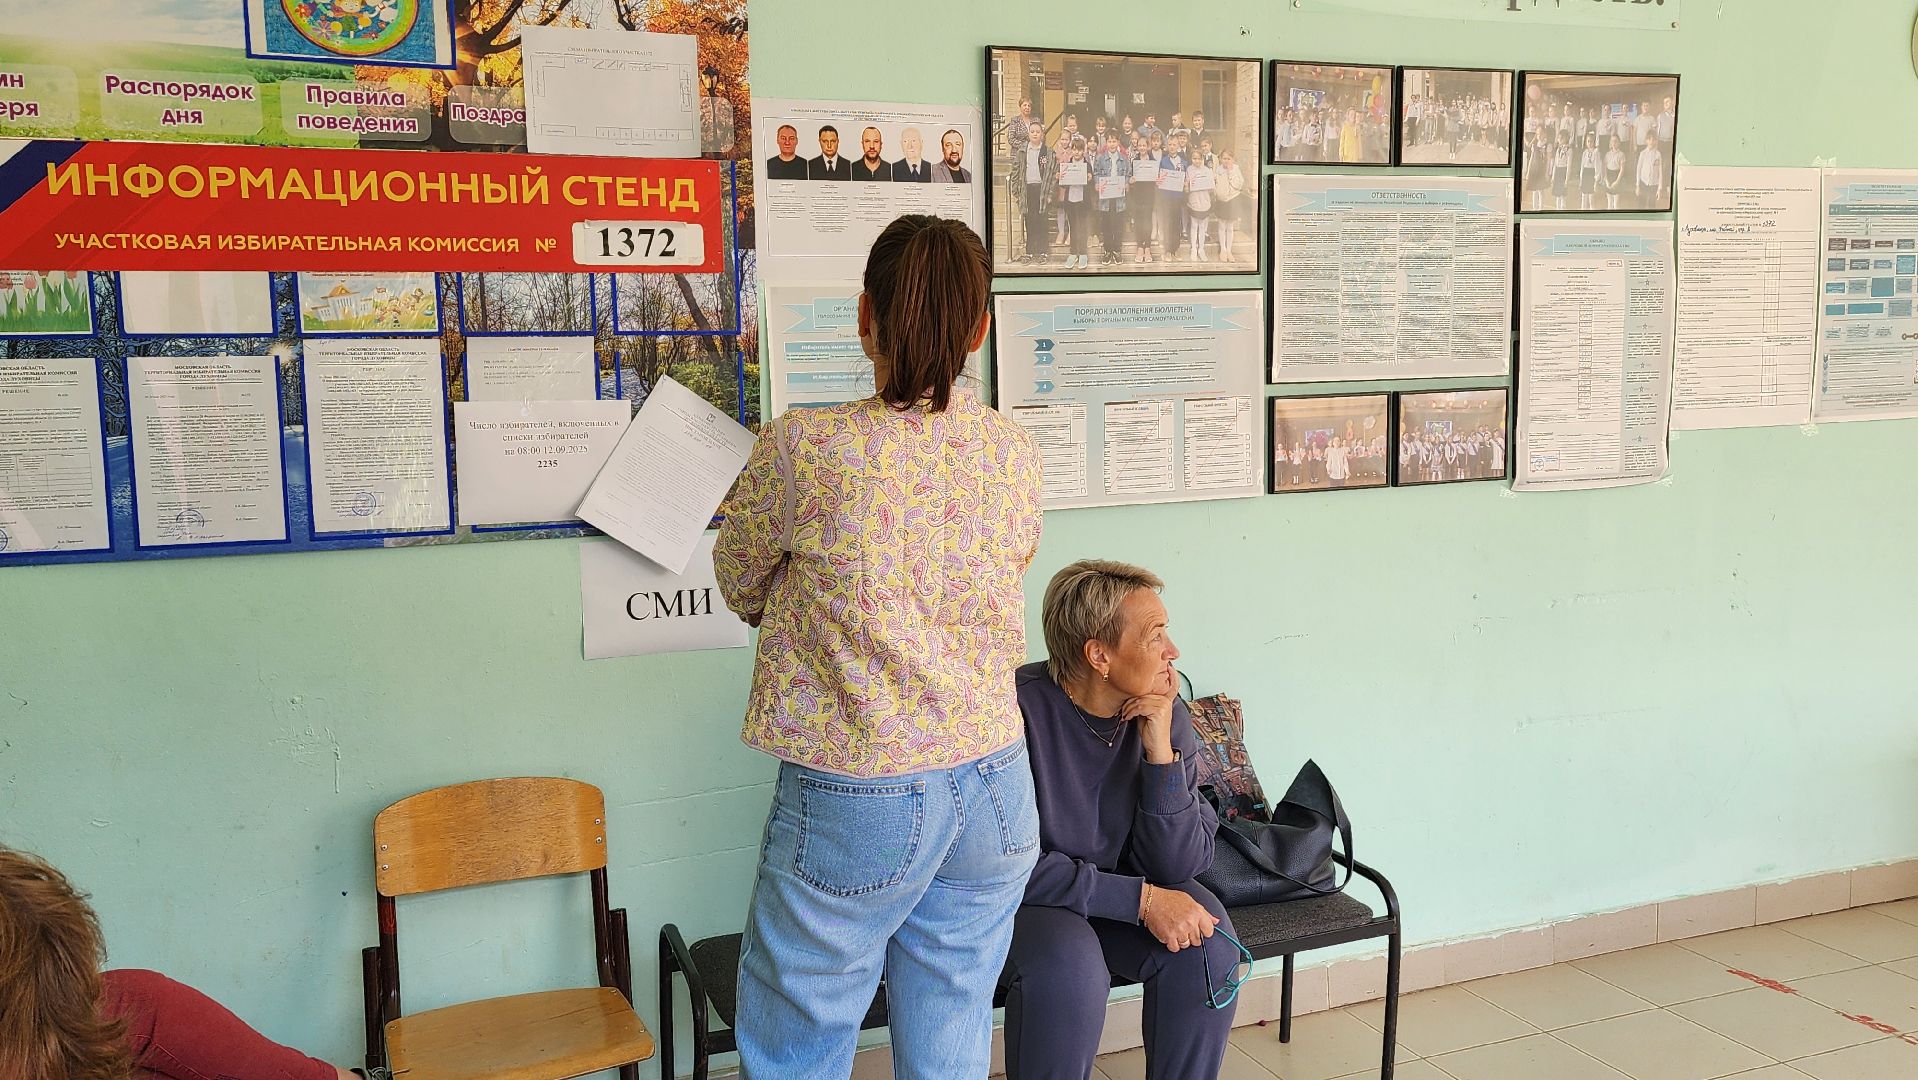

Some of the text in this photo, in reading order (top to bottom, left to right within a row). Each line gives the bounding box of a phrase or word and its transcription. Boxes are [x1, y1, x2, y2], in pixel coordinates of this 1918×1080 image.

[105, 75, 255, 101] Распорядок
[306, 84, 405, 108] Правила
[161, 109, 203, 129] дня
[298, 114, 419, 134] поведения
[47, 162, 700, 213] ИНФОРМАЦИОННЫЙ СТЕНД
[55, 228, 676, 257] УЧАСТКОВАЯ ИЗБИРАТЕЛЬНАЯ КОМИССИЯ № 1372
[1075, 305, 1193, 316] ПОРЯДОК ЗАПОЛНЕНИЯ БЮЛЛЕТЕНЯ
[469, 421, 497, 431] Число
[502, 431, 589, 443] списки избирателей
[505, 445, 588, 456] на 08:00 12.09.2025
[537, 460, 558, 468] 2235
[626, 588, 713, 621] СМИ
